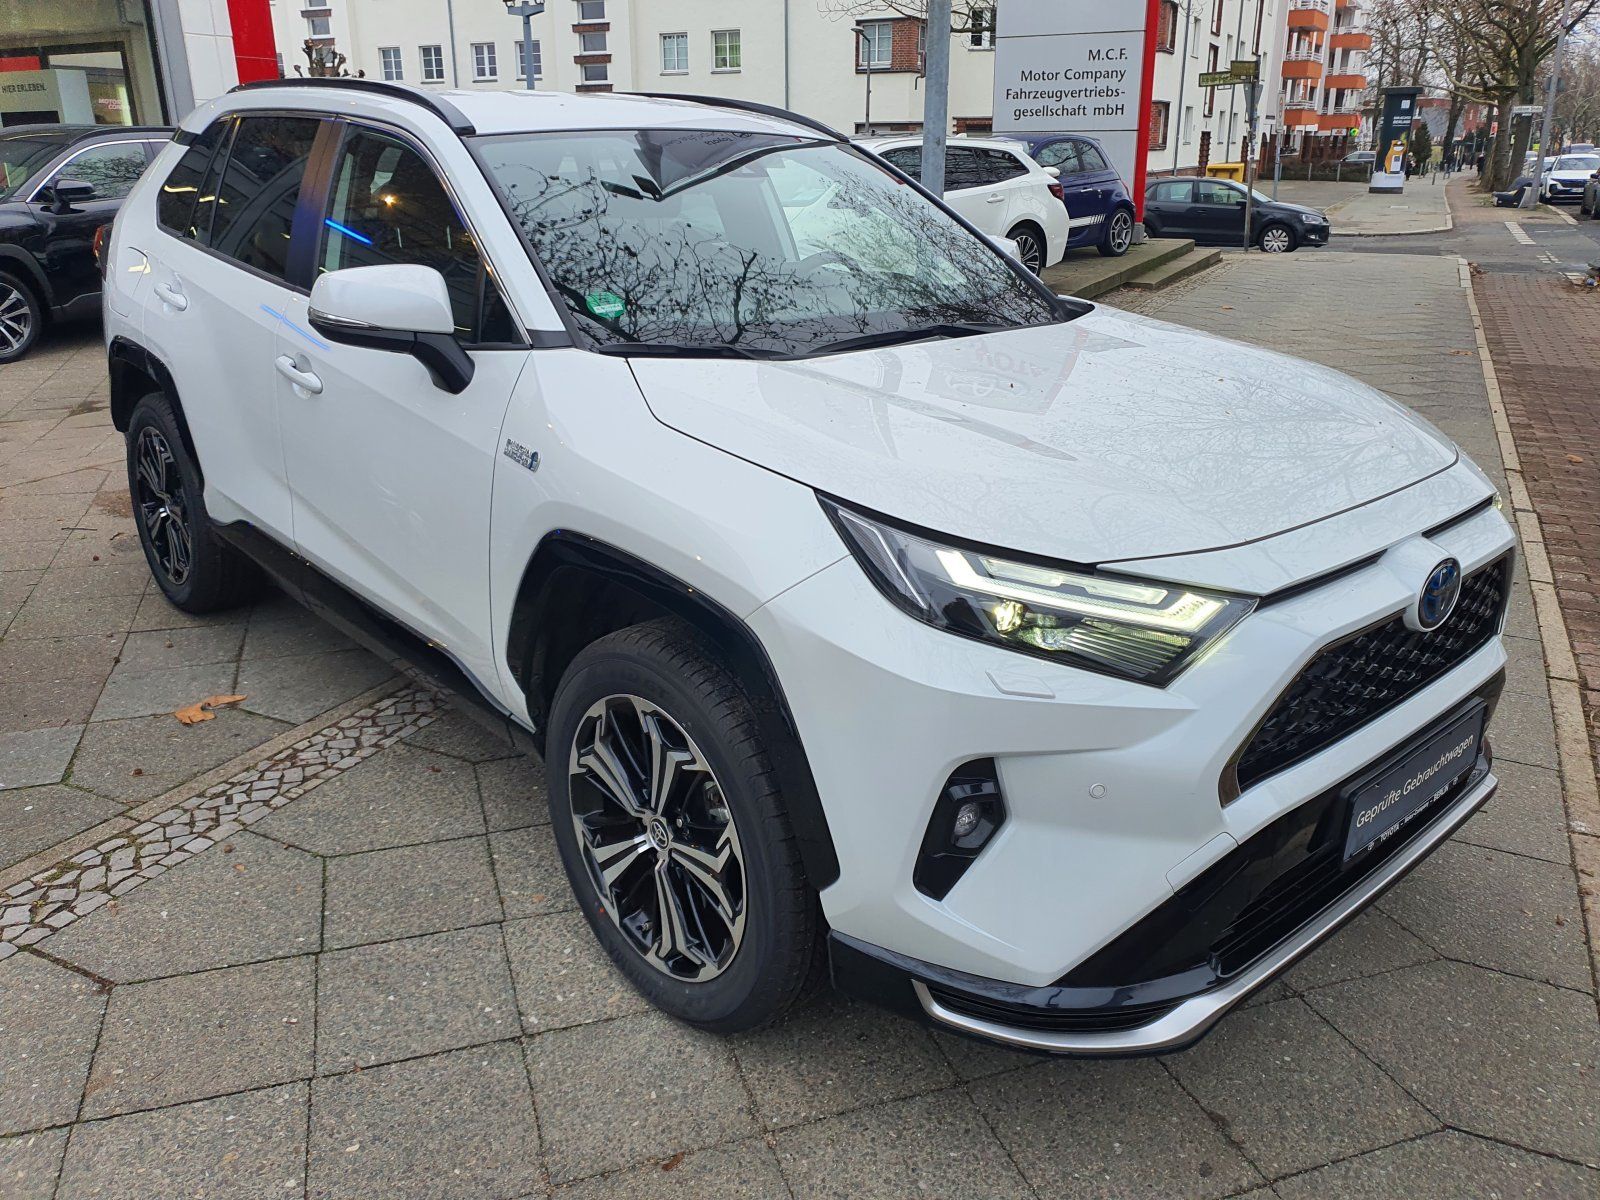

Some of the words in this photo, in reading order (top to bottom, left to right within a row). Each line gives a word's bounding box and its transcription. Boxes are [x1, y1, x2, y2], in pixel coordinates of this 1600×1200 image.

[1088, 48, 1128, 61] M.C.F.
[1020, 70, 1060, 82] Motor
[1064, 68, 1127, 83] Company
[1006, 86, 1126, 102] Fahrzeugvertriebs-
[1013, 105, 1087, 120] gesellschaft
[1093, 103, 1125, 116] mbH
[1356, 789, 1402, 828] Geprüfte
[1403, 734, 1474, 795] Gebrauchtwagen
